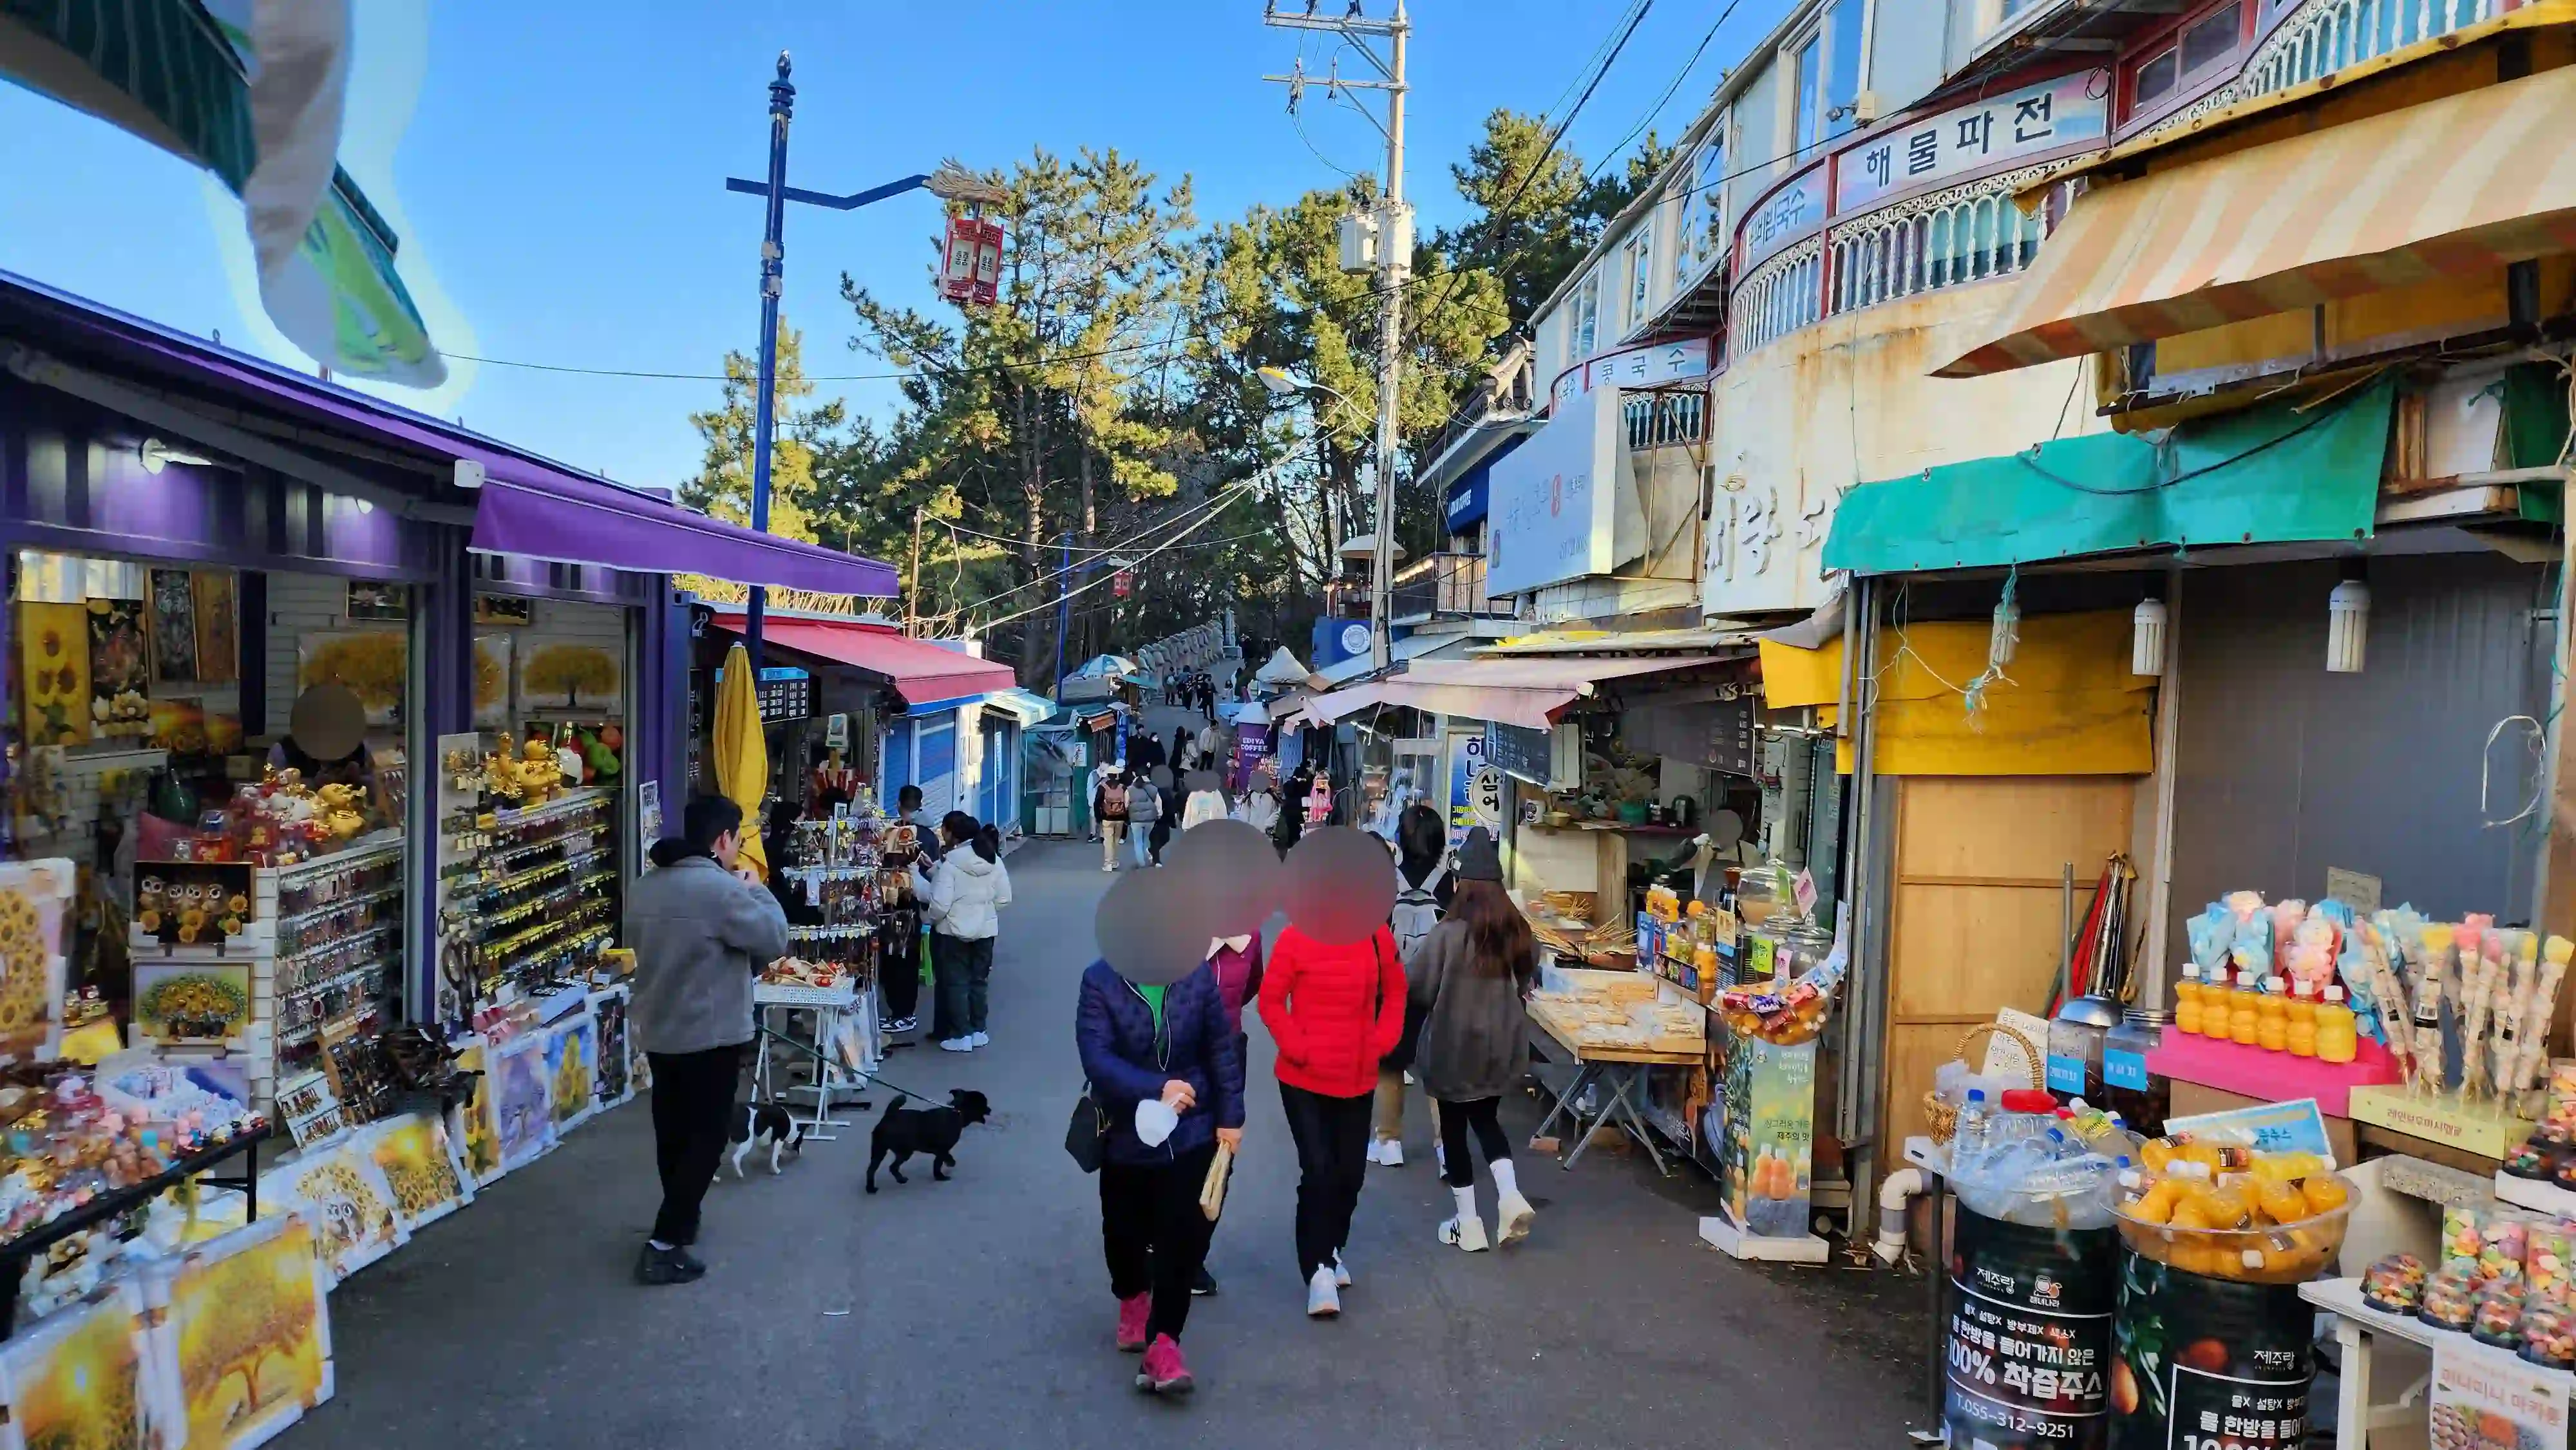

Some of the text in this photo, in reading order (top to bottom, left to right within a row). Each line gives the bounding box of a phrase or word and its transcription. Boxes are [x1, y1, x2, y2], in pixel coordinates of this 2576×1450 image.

[1866, 92, 2054, 189] 해물파전
[1601, 347, 1685, 386] 콩국수
[1240, 744, 1269, 752] COFFEE
[1777, 1131, 1799, 1142] 제주의
[1976, 1266, 2016, 1294] 제주랑
[1949, 1334, 2103, 1402] 100% 착즙주스
[2068, 1347, 2096, 1366] 않은
[2253, 1350, 2296, 1371] 제주랑
[1956, 1392, 2074, 1440] T.055-312-9251
[2257, 1398, 2284, 1411] 설탕X
[2199, 1411, 2219, 1433] 물
[2279, 1417, 2304, 1440] 들어
